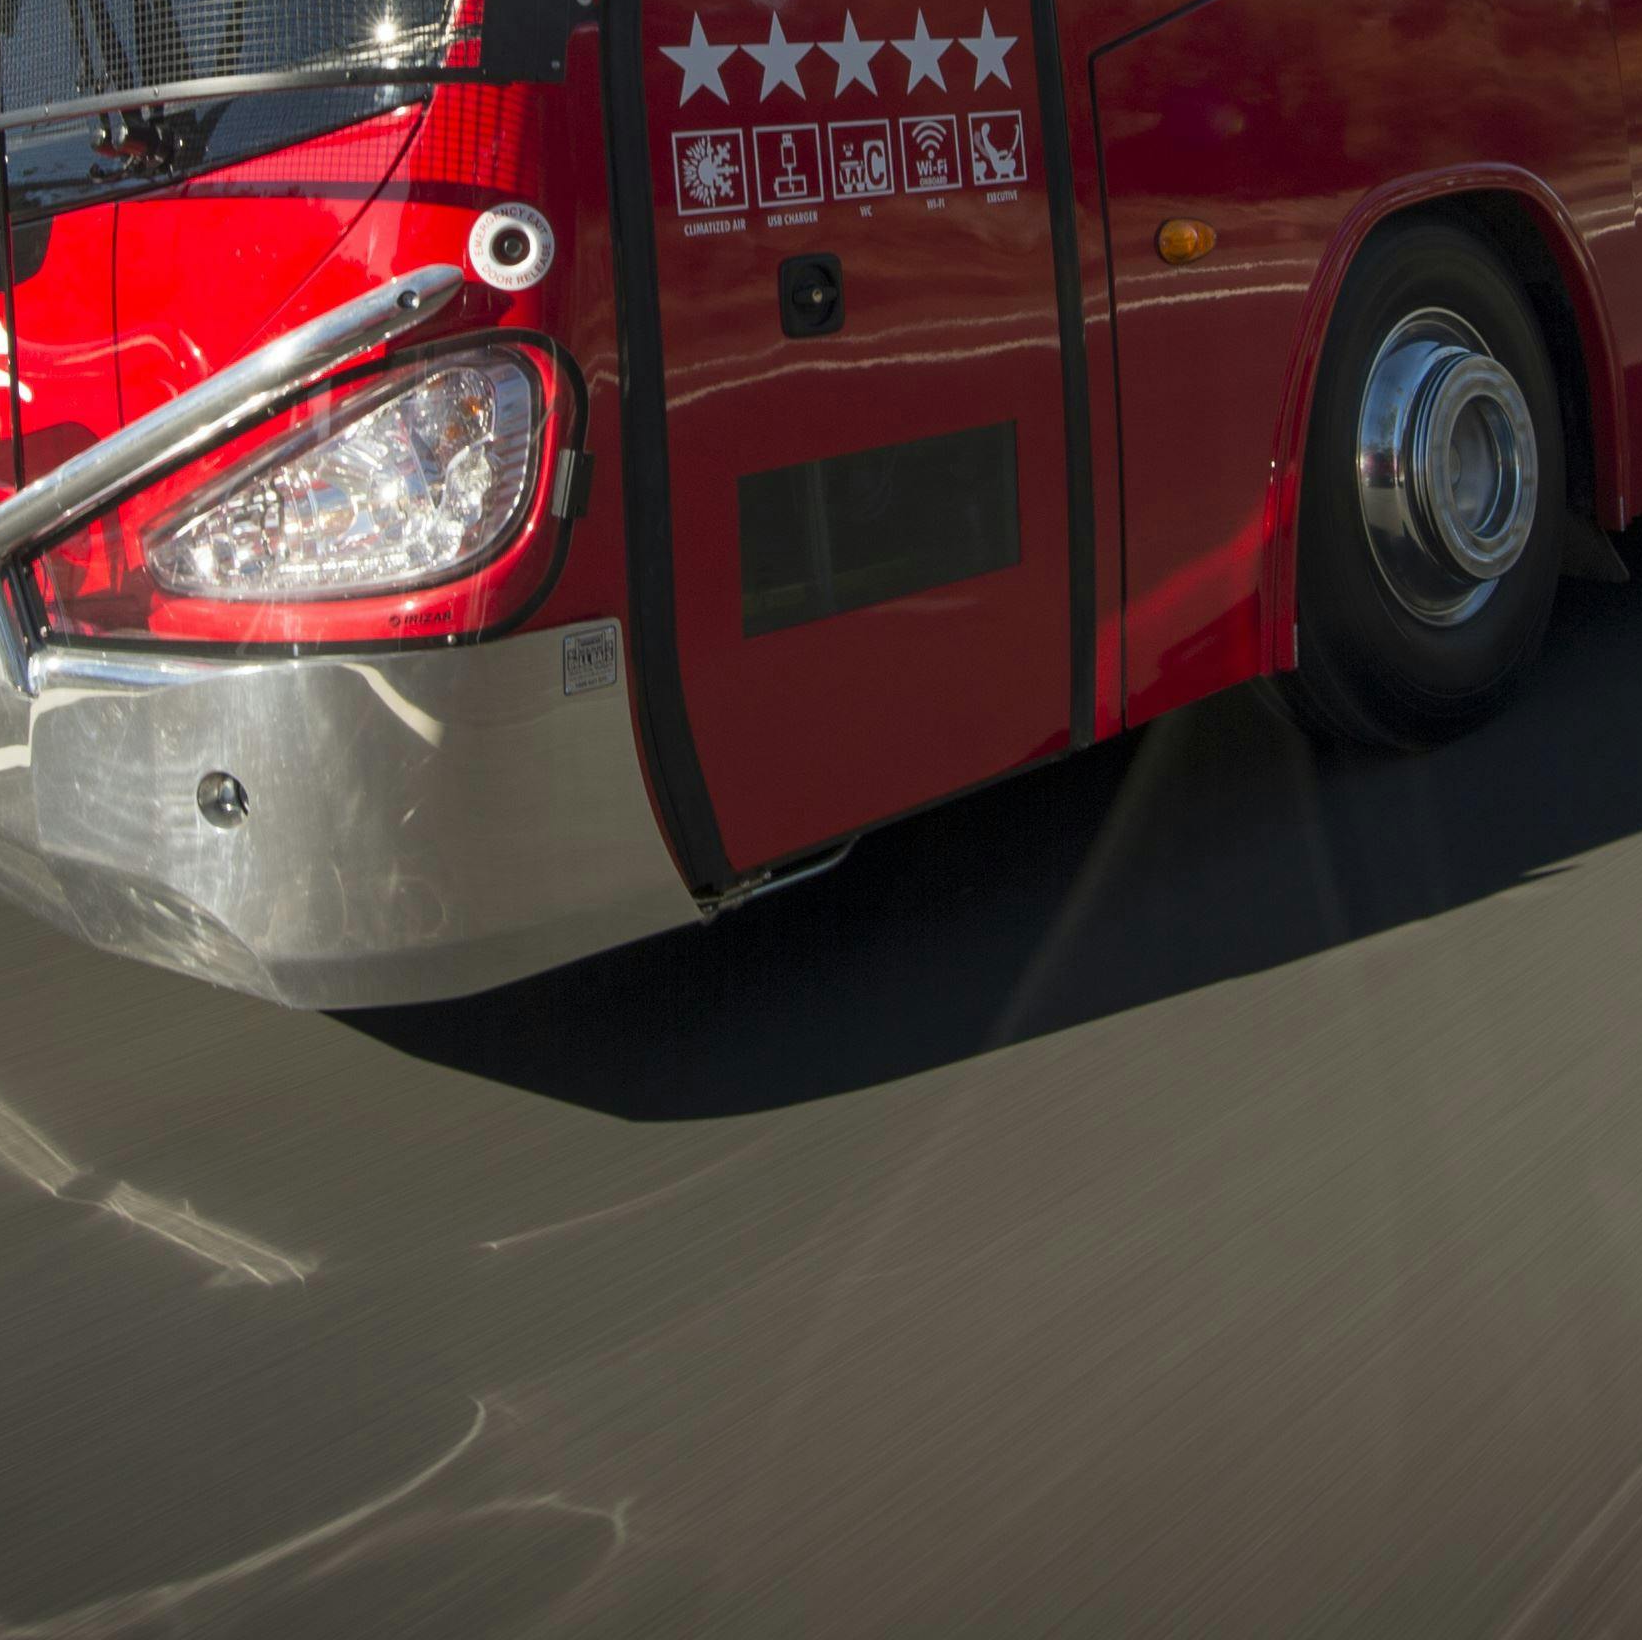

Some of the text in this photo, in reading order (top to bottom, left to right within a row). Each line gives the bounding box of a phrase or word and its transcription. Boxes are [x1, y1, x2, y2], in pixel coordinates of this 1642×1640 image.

[916, 158, 948, 177] Wi-Fi
[986, 190, 1018, 204] EXECUTIVE
[767, 210, 819, 228] USB CHARGER
[859, 204, 873, 217] WC
[684, 217, 747, 237] CLIMATIZED AIR
[481, 263, 513, 286] DOOR
